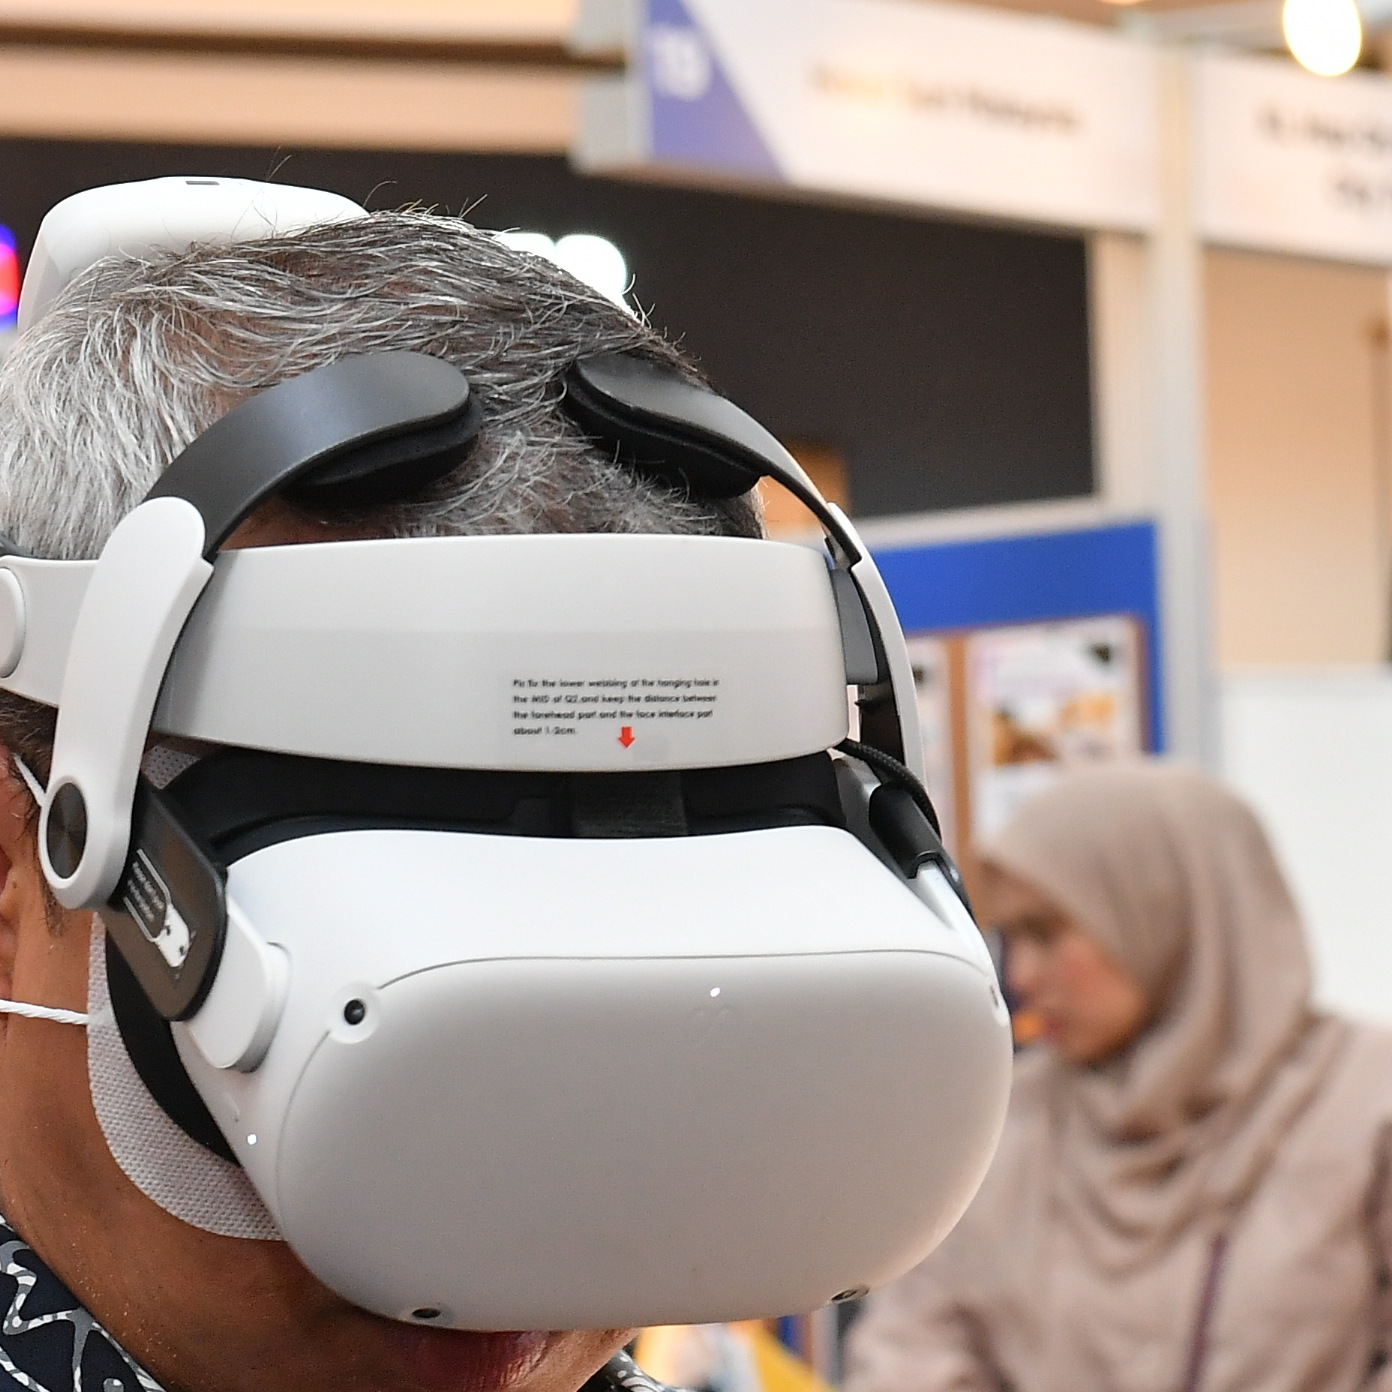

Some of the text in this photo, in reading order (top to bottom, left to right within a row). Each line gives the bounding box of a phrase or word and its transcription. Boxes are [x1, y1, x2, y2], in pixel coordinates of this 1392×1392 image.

[658, 678, 692, 690] hanging
[645, 694, 680, 704] distance
[683, 694, 717, 704] between
[532, 710, 575, 720] forehead
[578, 710, 596, 721] part
[697, 709, 713, 720] part
[513, 726, 542, 736] about
